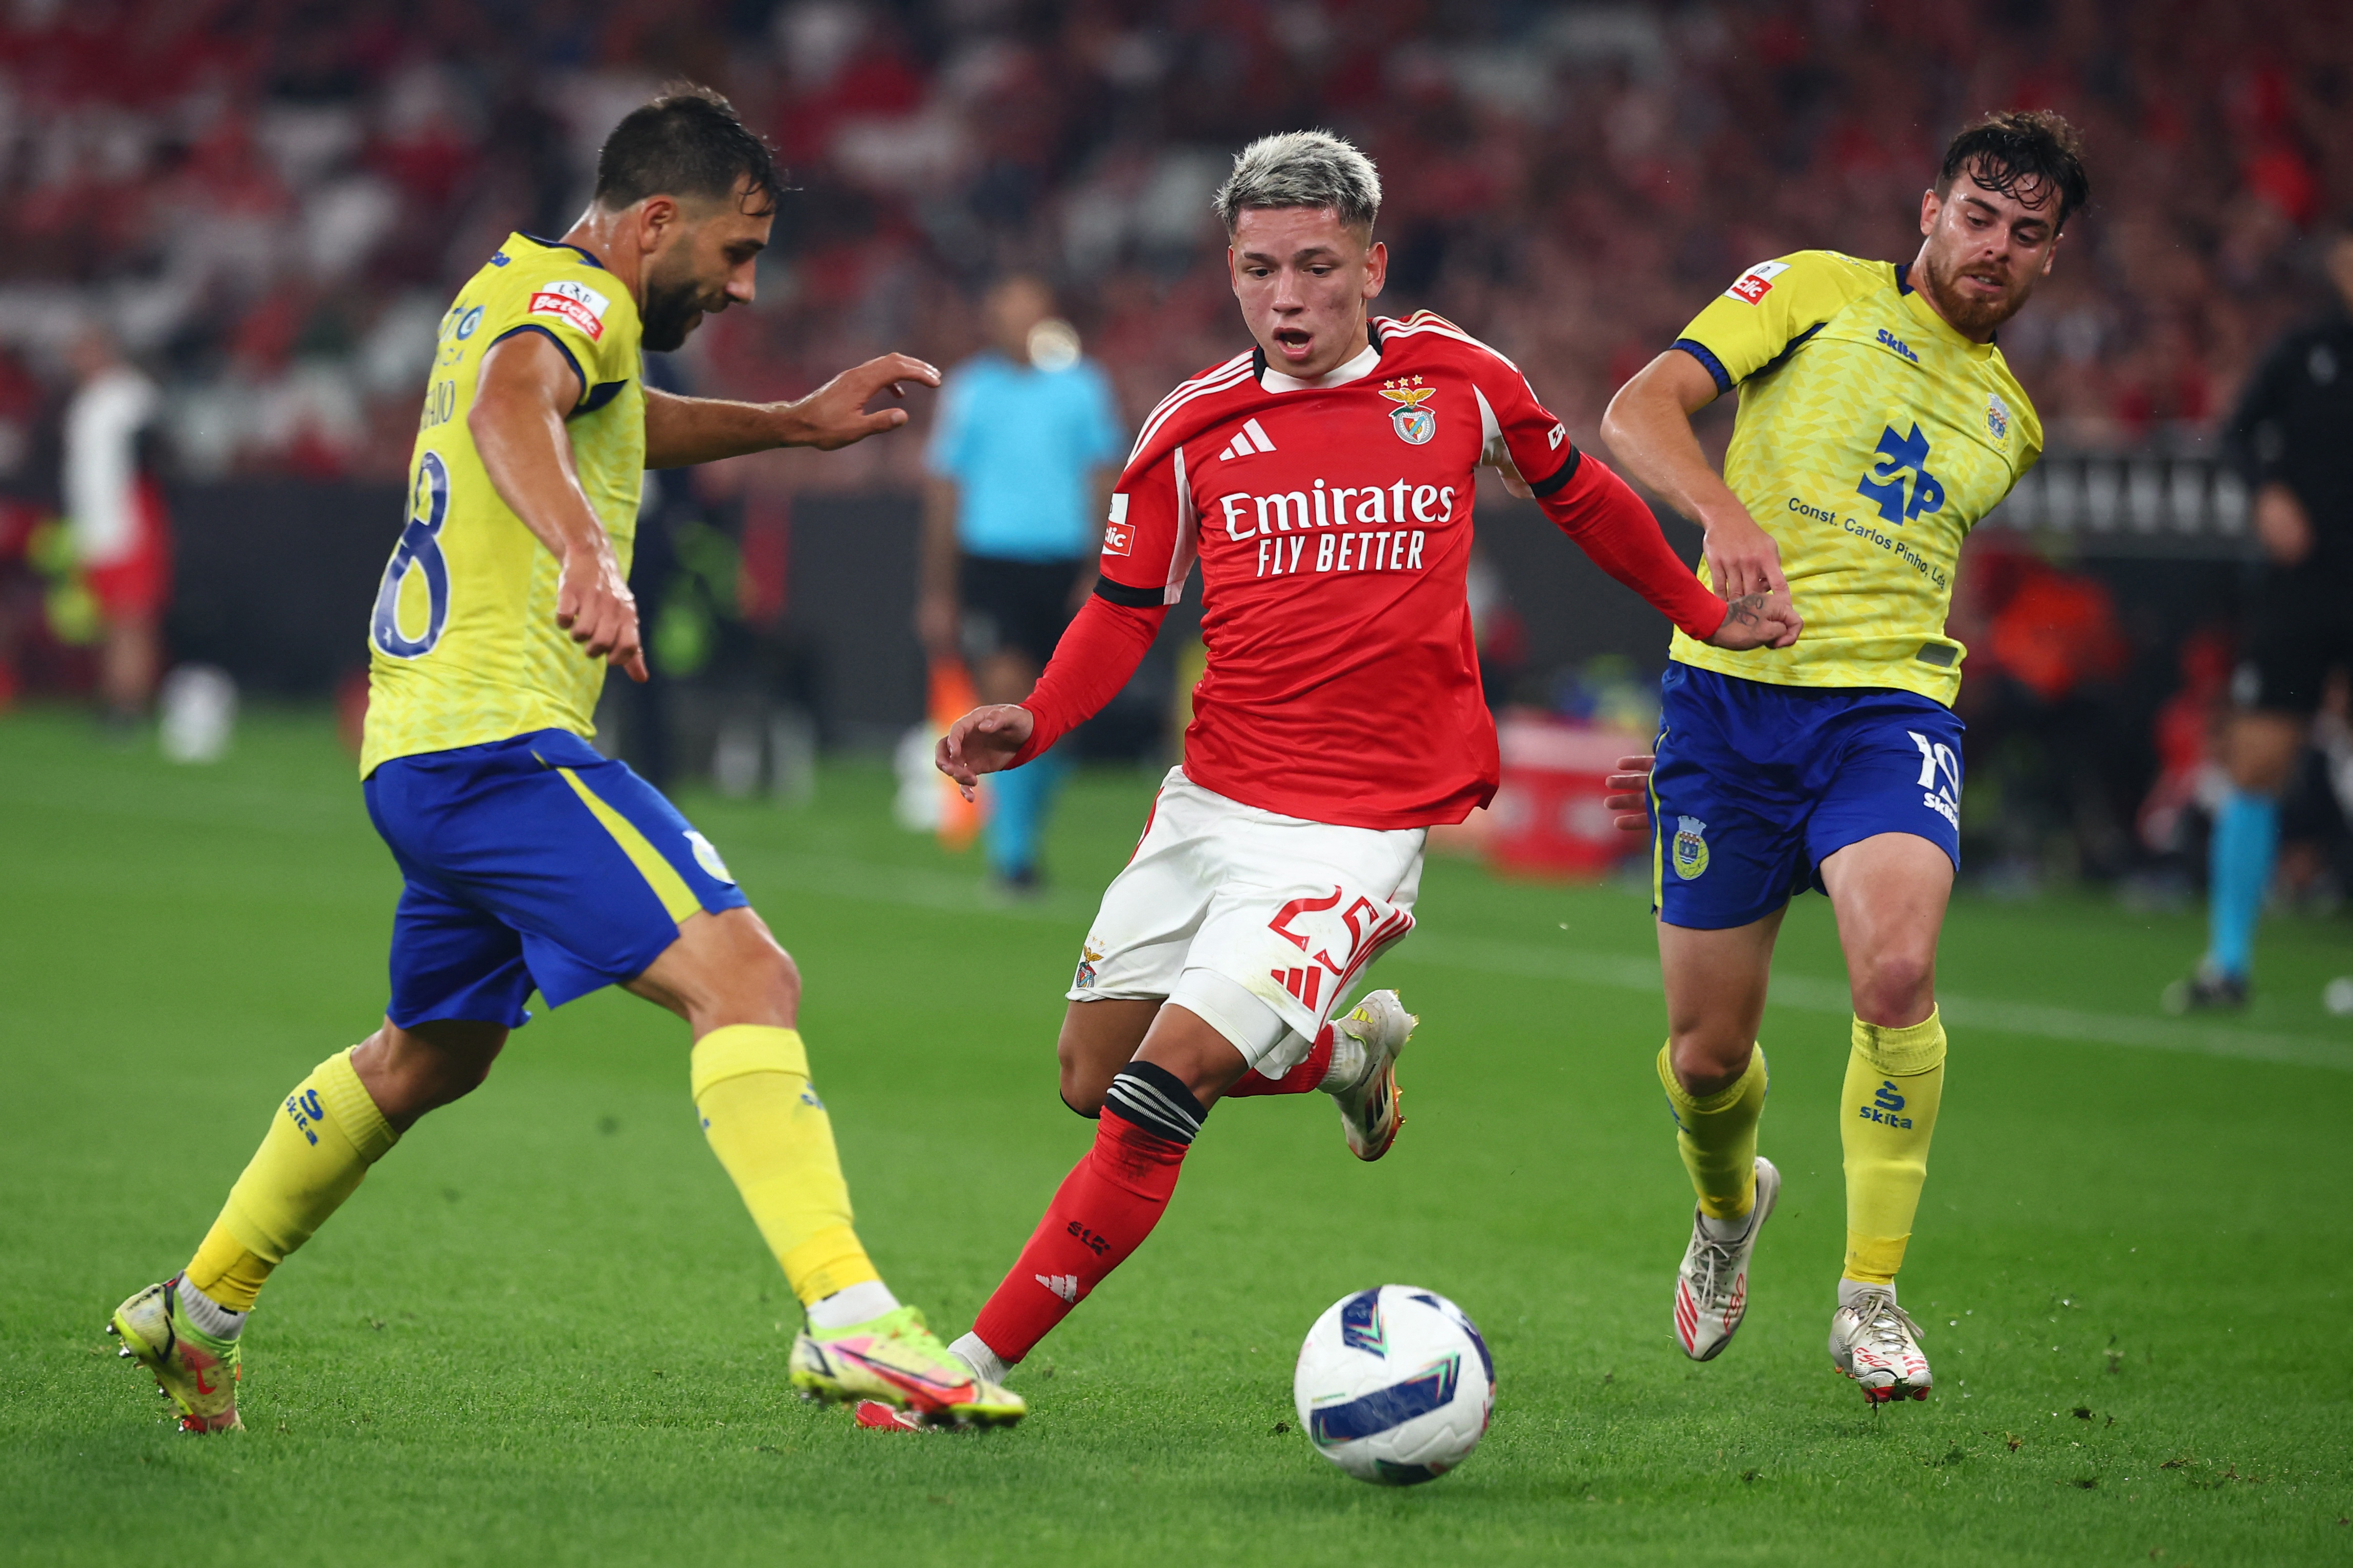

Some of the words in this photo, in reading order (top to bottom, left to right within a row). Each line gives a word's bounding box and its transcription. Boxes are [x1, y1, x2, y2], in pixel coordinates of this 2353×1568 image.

[532, 295, 598, 334] Betclic
[1876, 328, 1918, 363] Skita
[1218, 477, 1455, 542] Emirates
[1788, 497, 1838, 526] Const.
[1844, 518, 1892, 550] Carlos
[1894, 542, 1929, 577] Pinho,
[1256, 535, 1305, 577] FLY
[1315, 530, 1426, 572] BETTER
[1907, 731, 1959, 813] 19
[1268, 884, 1380, 976] 25
